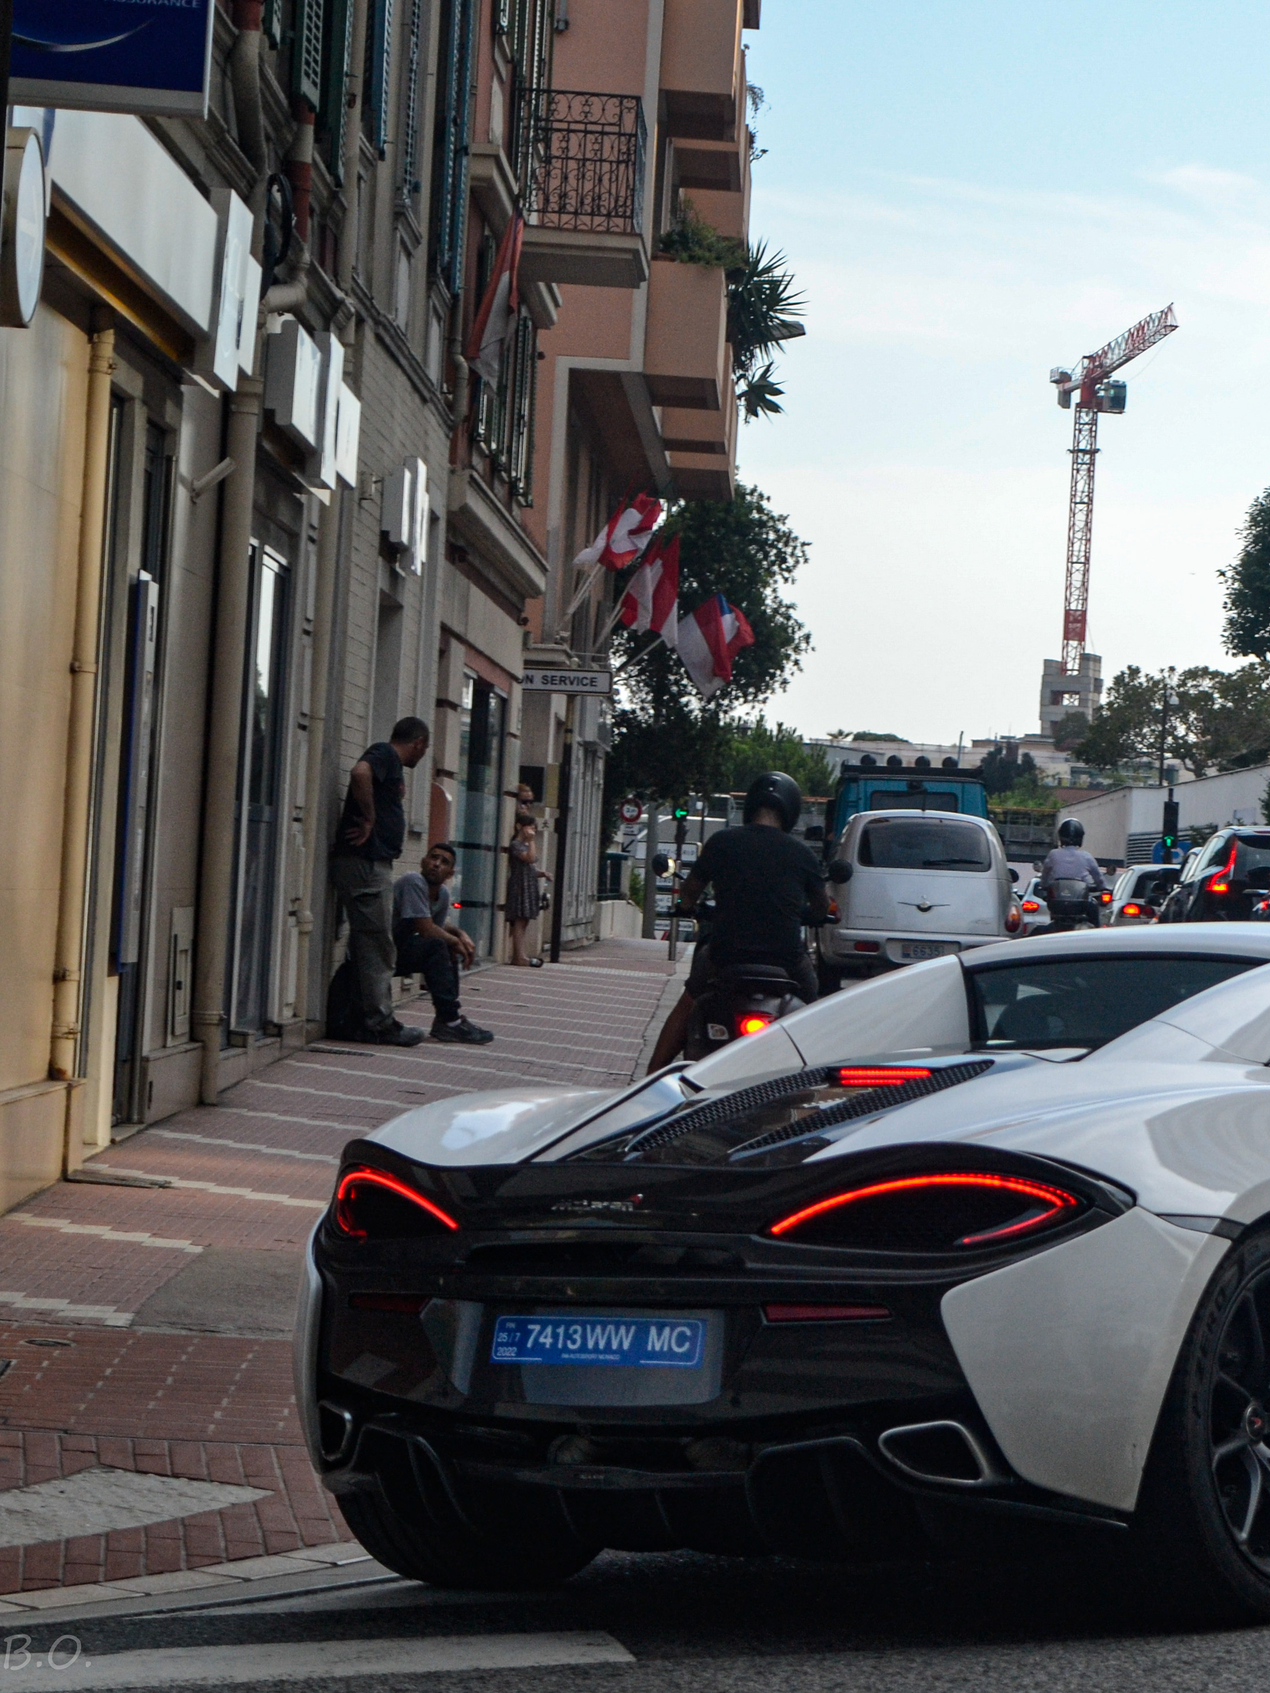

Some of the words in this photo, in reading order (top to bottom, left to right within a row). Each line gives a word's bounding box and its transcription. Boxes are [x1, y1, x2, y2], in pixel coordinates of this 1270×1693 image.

[541, 674, 598, 687] SERVICE
[647, 1325, 692, 1353] MC
[496, 1346, 518, 1357] 2022
